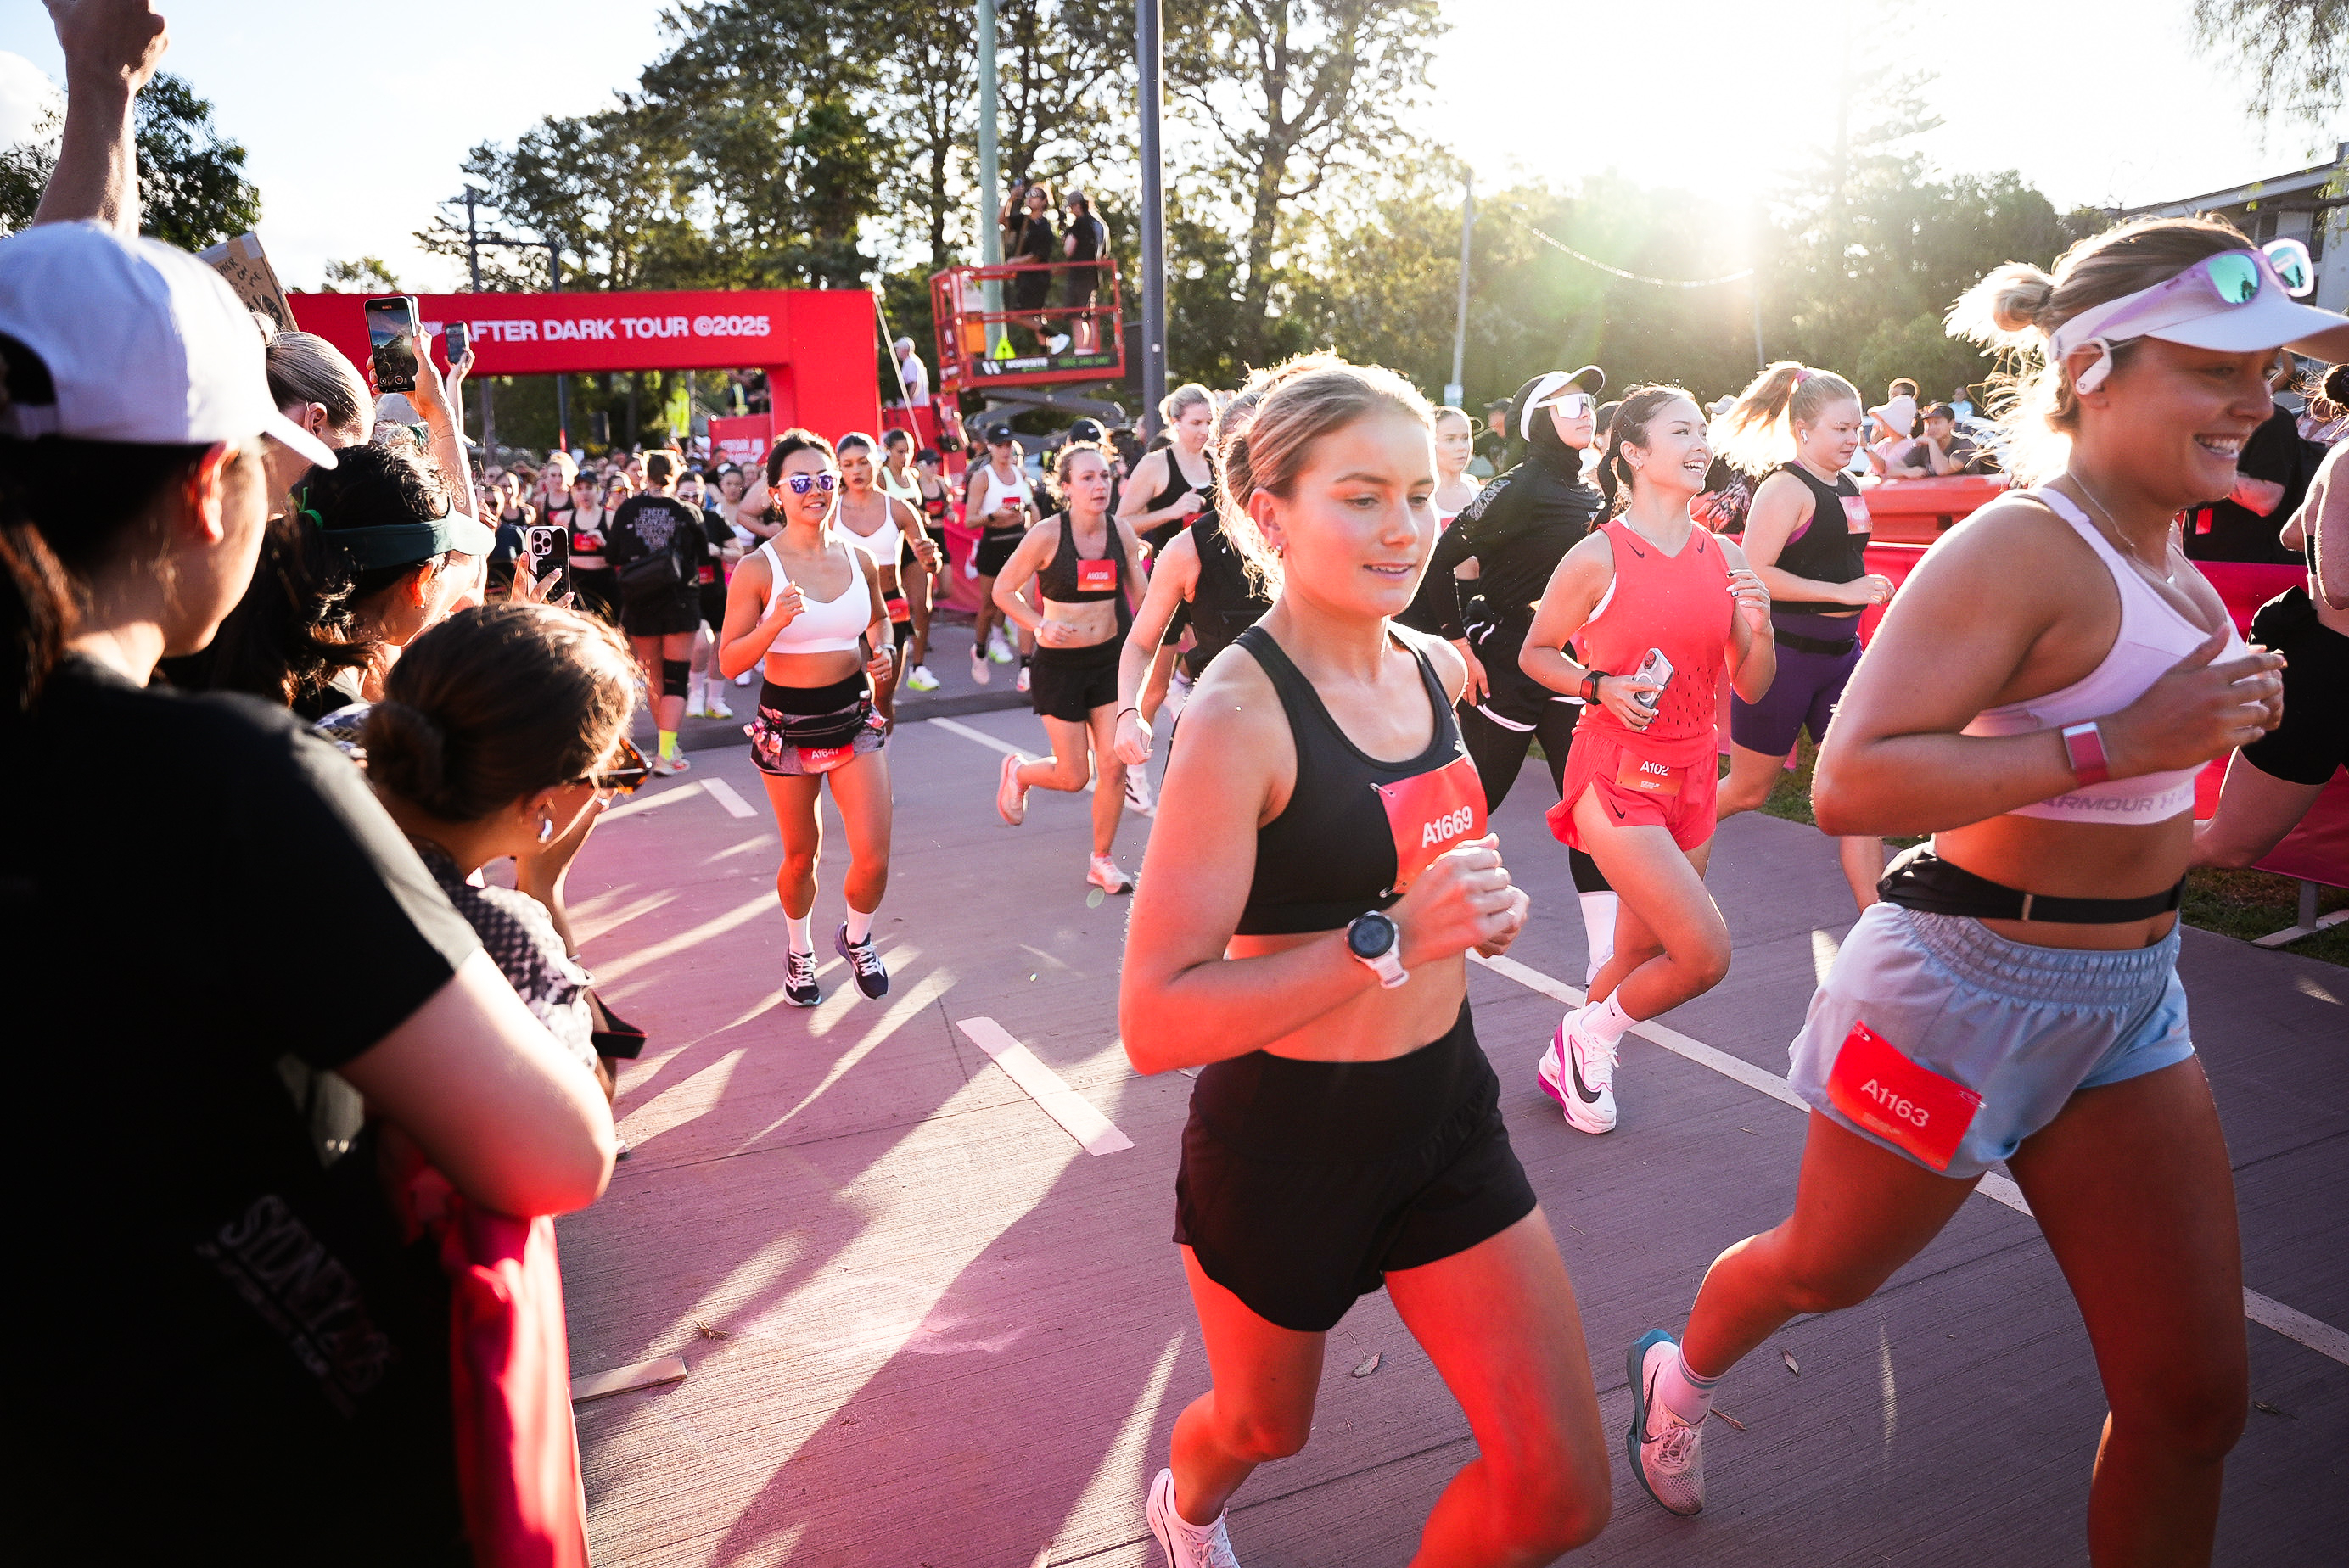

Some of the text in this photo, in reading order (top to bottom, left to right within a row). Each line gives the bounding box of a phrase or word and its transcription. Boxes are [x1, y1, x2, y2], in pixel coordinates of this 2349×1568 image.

[542, 317, 617, 341] DARK
[619, 315, 691, 339] TOUR
[1421, 805, 1474, 848] A1669
[1859, 1078, 1930, 1128] A1163
